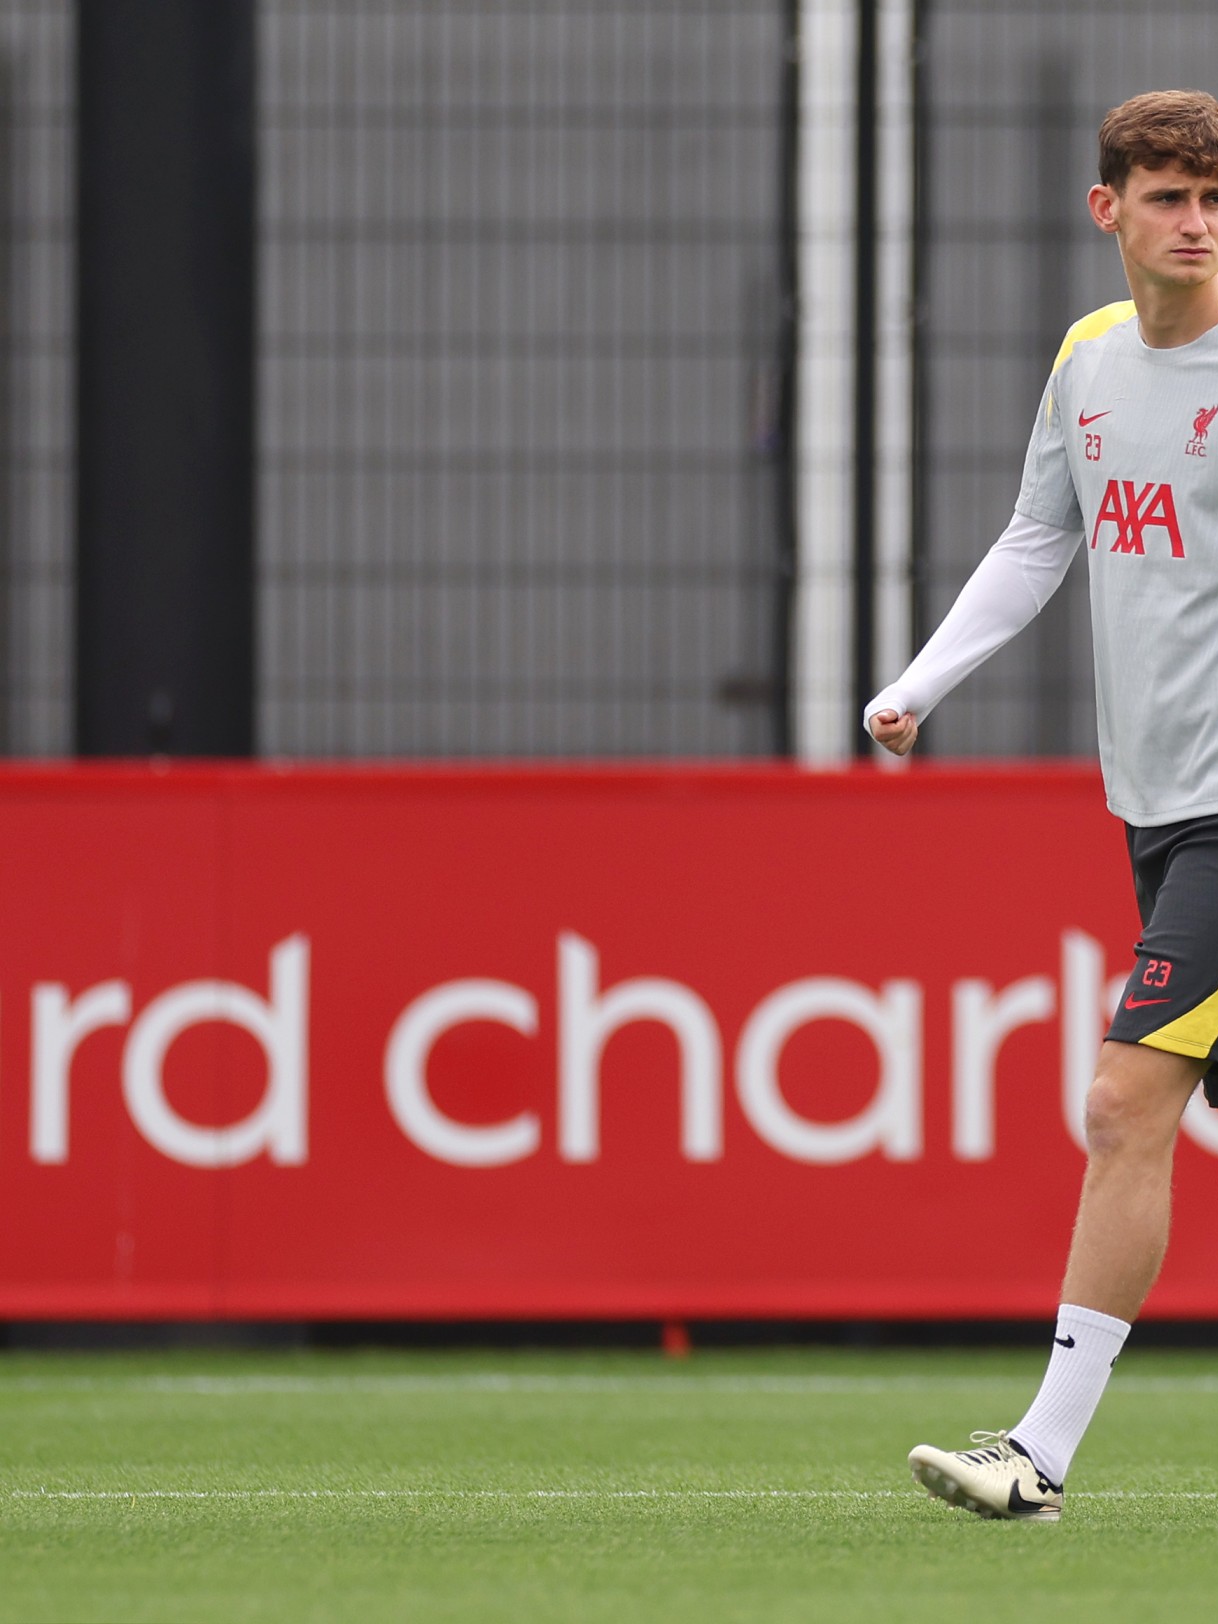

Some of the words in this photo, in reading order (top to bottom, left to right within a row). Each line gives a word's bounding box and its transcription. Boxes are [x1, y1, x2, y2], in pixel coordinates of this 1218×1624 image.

[1085, 433, 1101, 461] 23
[1090, 479, 1185, 559] AXA
[1143, 959, 1172, 987] 23
